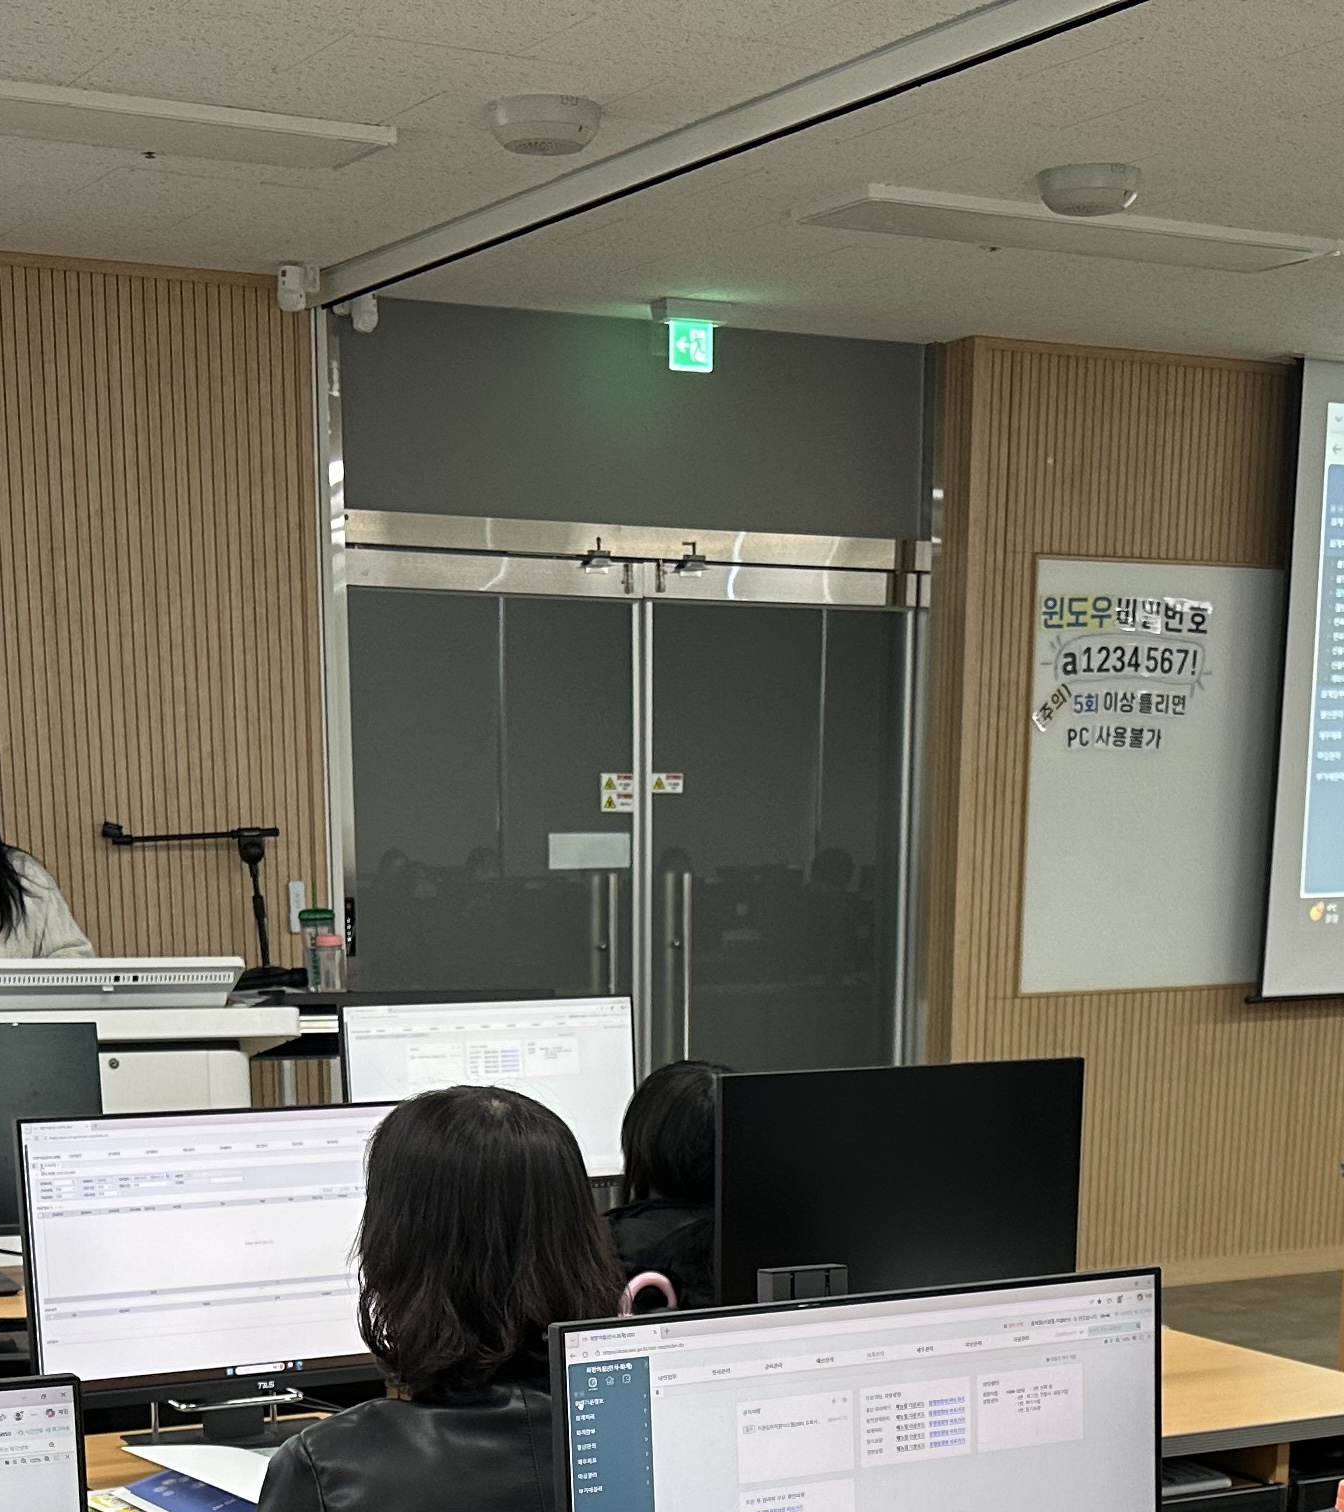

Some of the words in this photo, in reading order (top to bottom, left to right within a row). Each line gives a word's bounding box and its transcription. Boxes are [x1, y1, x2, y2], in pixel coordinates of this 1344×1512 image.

[1042, 596, 1113, 630] 윈도우
[1061, 646, 1199, 677] a1234567!
[1072, 694, 1099, 714] 5회
[1067, 727, 1090, 748] PC
[1095, 726, 1162, 750] 사용불가
